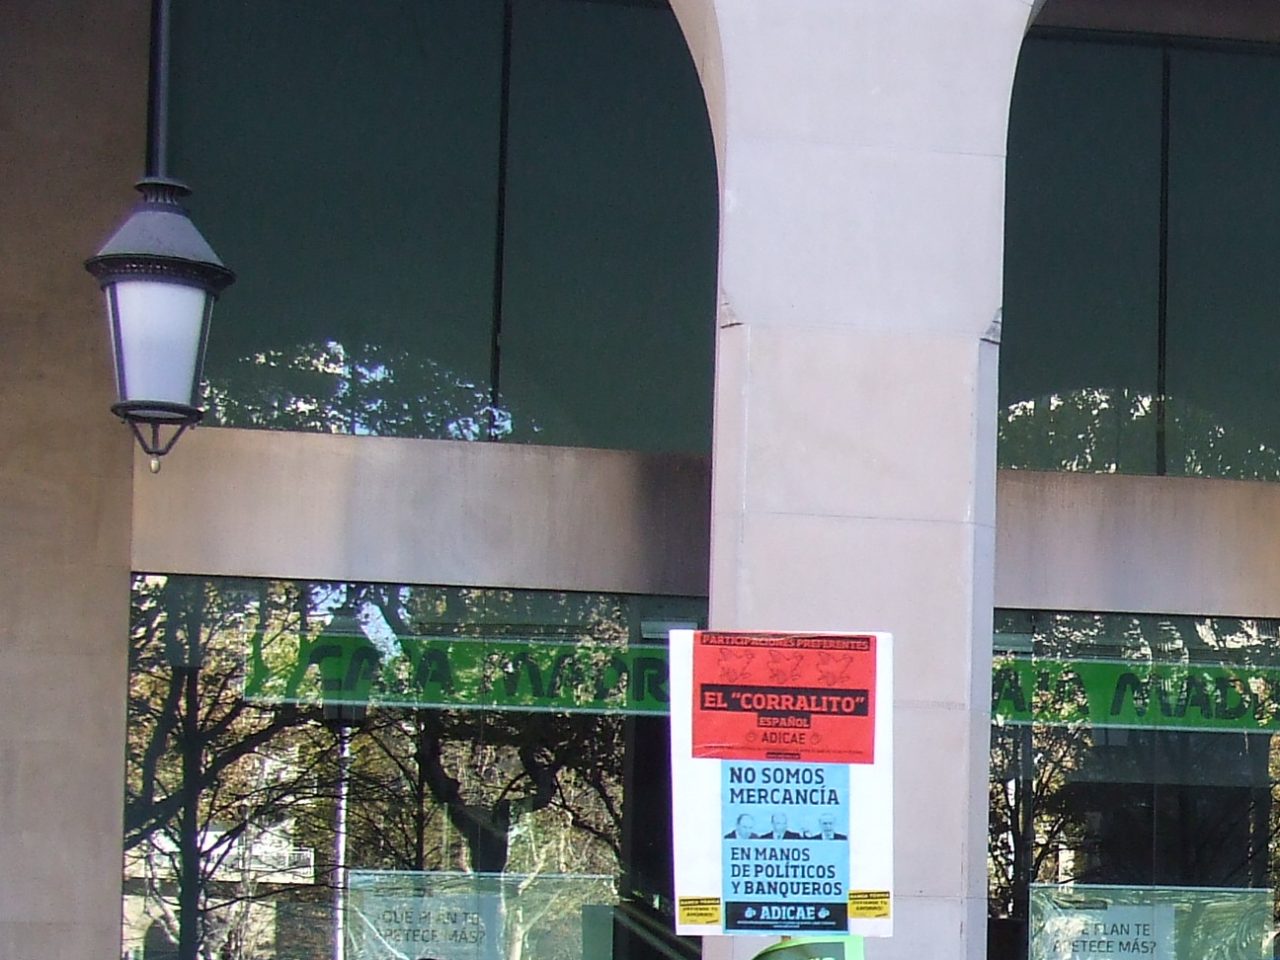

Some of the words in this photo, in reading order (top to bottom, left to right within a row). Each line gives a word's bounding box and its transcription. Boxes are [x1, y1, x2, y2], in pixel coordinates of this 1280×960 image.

[704, 691, 728, 708] EL
[731, 692, 865, 713] "CORRALITO"
[759, 716, 810, 728] ESPAÑOL
[761, 732, 806, 745] ADICAE
[729, 767, 756, 784] NO
[762, 768, 824, 785] SOMOS
[729, 785, 840, 805] MERCANCÍA
[731, 847, 751, 861] EN
[755, 848, 810, 861] MANOS
[731, 864, 754, 878] DE
[754, 862, 836, 879] POLÍTICOS
[732, 881, 741, 895] Y
[744, 881, 843, 896] BANQUEROS
[760, 906, 816, 920] ADICAE
[1135, 923, 1150, 936] TE
[1119, 938, 1157, 953] MÁS?
